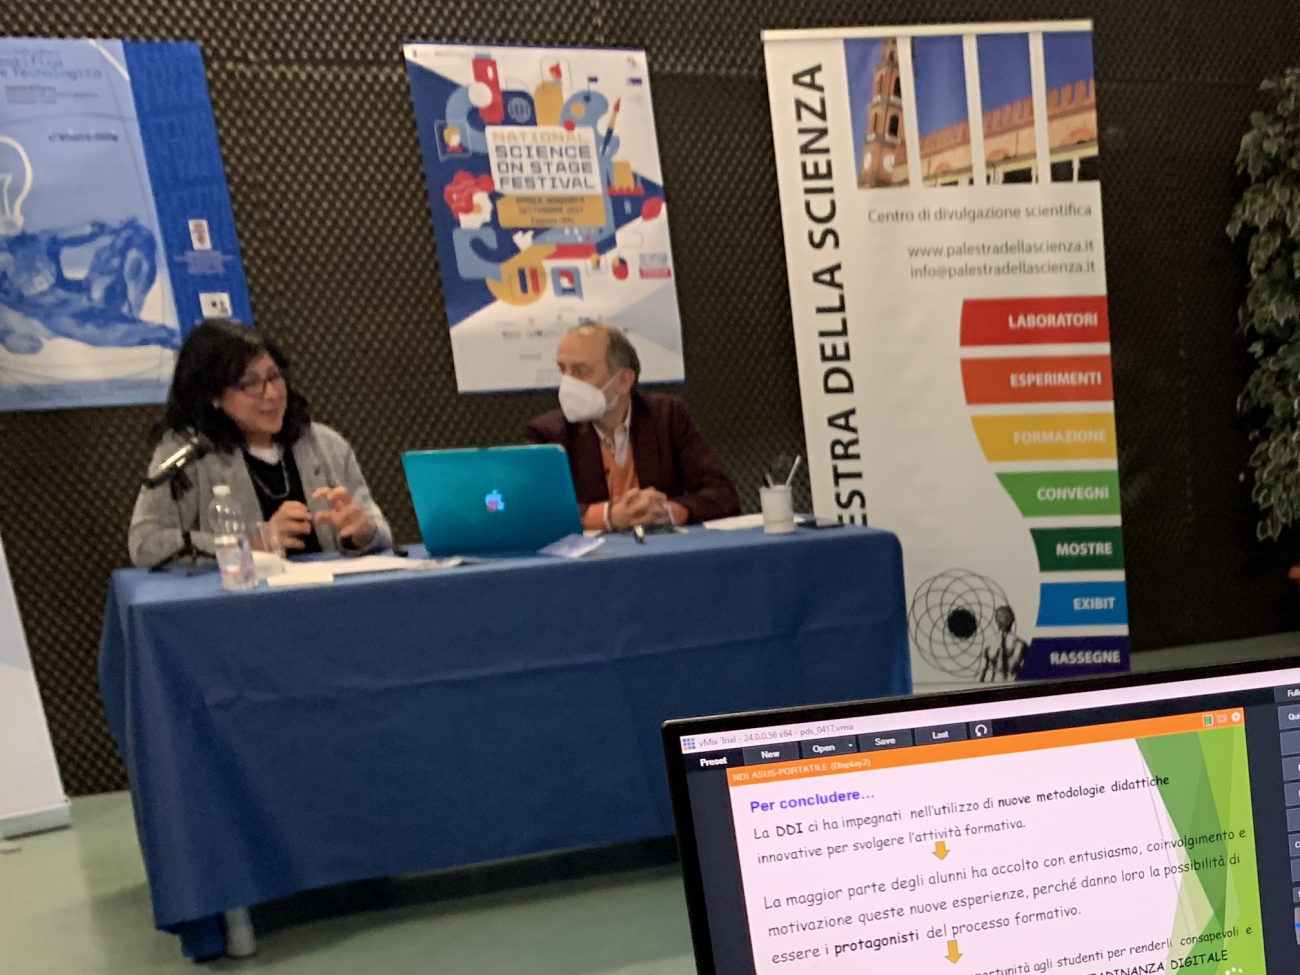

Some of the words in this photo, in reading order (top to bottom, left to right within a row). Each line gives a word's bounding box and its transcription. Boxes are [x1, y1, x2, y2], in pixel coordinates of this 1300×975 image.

[492, 131, 588, 143] NATIONAL
[495, 145, 591, 159] SCIENCE
[792, 63, 840, 250] SCIENZA
[497, 161, 523, 174] ON
[530, 161, 592, 174] STAGE
[499, 176, 595, 189] FESTIVAL
[868, 209, 914, 223] Centro
[918, 207, 931, 221] di
[934, 205, 1021, 223] divulgazione
[1024, 203, 1092, 218] scientifica
[907, 239, 1094, 258] www.palestradellascienza.it
[910, 260, 1096, 279] info@palestradellascienza.it
[811, 262, 855, 395] DELLA
[1008, 313, 1098, 329] LABORATORI
[1010, 371, 1101, 388] ESPERIMENTI
[1013, 429, 1106, 445] FORMAZIONE
[1037, 486, 1109, 501] CONVEGNI
[1056, 541, 1113, 557] MOSTRE
[1072, 597, 1115, 611] EXIBIT
[1049, 650, 1121, 665] RASSEGNE
[699, 737, 718, 747] vMix
[721, 736, 736, 745] Trial
[744, 730, 777, 742] 24.0.0.56
[778, 729, 792, 738] x64
[700, 757, 727, 767] Preset
[761, 750, 780, 759] New
[812, 743, 835, 753] Open
[875, 737, 896, 745] Save
[932, 730, 949, 739] Last
[732, 772, 749, 782] NDI
[752, 763, 829, 779] ASUS-PORTATILE
[831, 758, 871, 772] (Display2)
[750, 800, 775, 813] Per
[779, 789, 875, 809] concludere...
[754, 828, 770, 840] La
[776, 823, 804, 837] DDI
[808, 820, 818, 833] ci
[822, 818, 839, 830] ha
[841, 811, 902, 833] impegnati
[910, 799, 979, 819] nell'utilizzo
[983, 798, 994, 809] di
[998, 794, 1032, 807] nuove
[1036, 784, 1105, 802] metodologie
[1110, 775, 1170, 793] didattiche
[757, 844, 822, 865] innovative
[827, 842, 849, 857] per
[853, 834, 905, 853] svolgere
[909, 825, 962, 843] l'attività
[965, 819, 1026, 836] formativa.
[764, 896, 782, 910] La
[785, 889, 843, 911] maggior
[848, 881, 887, 900] parte
[891, 875, 925, 894] degli
[928, 869, 967, 886] alunni
[971, 865, 988, 878] ha
[992, 859, 1039, 876] accolto
[1043, 856, 1065, 868] con
[1069, 843, 1143, 865] entusiasmo,
[1146, 830, 1235, 852] coinvolgimento
[1238, 829, 1246, 838] e
[768, 915, 853, 937] motivazione
[858, 907, 905, 926] queste
[909, 900, 947, 915] nuove
[952, 889, 1029, 909] esperienze,
[1032, 877, 1077, 898] perché
[1080, 874, 1117, 889] danno
[1121, 869, 1145, 882] loro
[1149, 866, 1161, 878] la
[1164, 855, 1225, 878] possibilità
[1229, 854, 1240, 865] di
[772, 947, 821, 964] essere
[834, 930, 919, 957] protagonisti
[926, 924, 948, 939] del
[952, 917, 1010, 938] processo
[1015, 905, 1081, 925] formativo.
[1034, 959, 1053, 972] agli
[1057, 950, 1104, 968] studenti
[1107, 948, 1126, 961] per
[1129, 938, 1173, 955] renderli
[1180, 927, 1239, 948] consapevoli
[1246, 926, 1252, 935] e
[1171, 949, 1228, 970] DIGITALE
